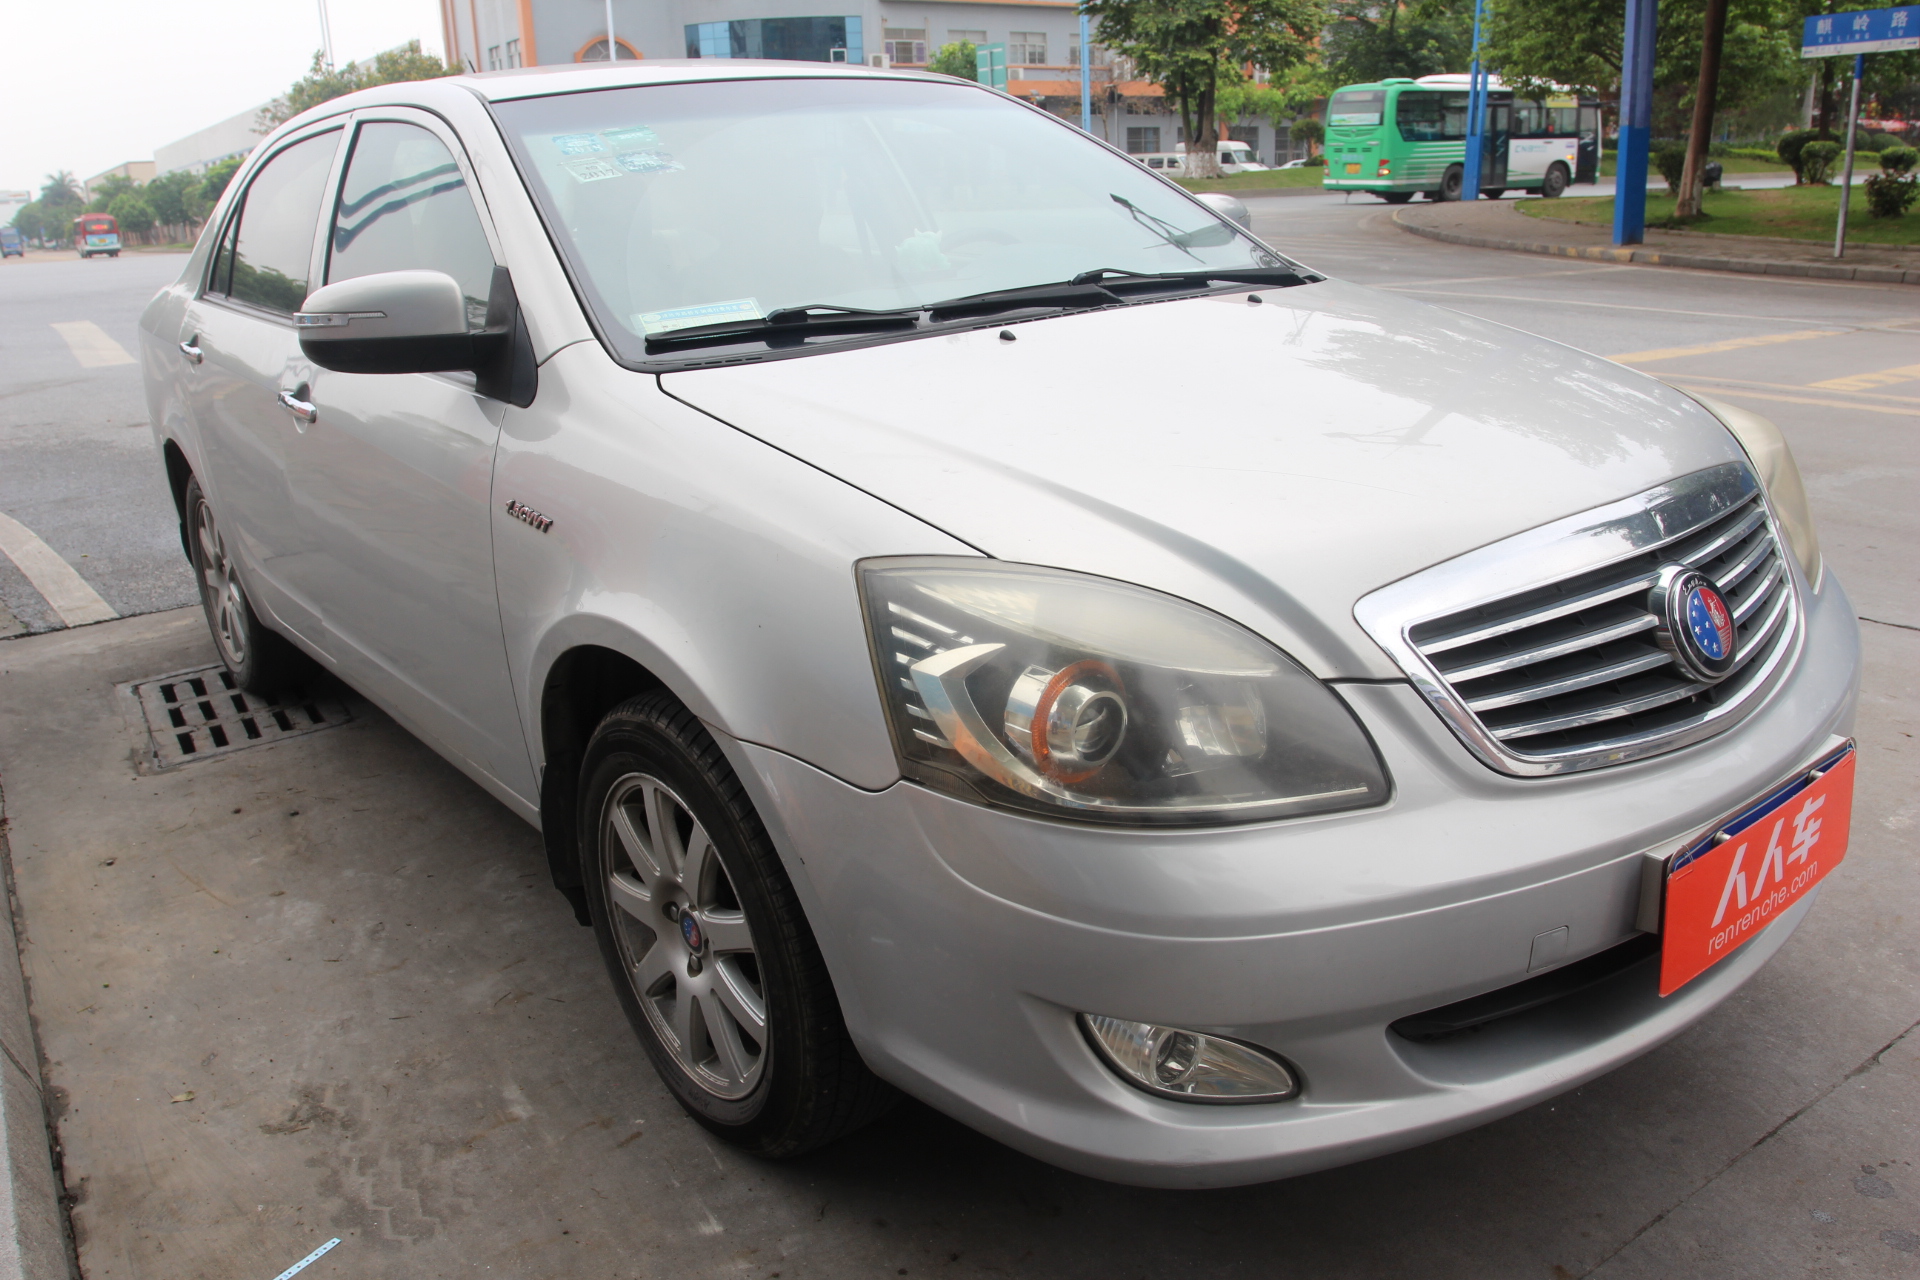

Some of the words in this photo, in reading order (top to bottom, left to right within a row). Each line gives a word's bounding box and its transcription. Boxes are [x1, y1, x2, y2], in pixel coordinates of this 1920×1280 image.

[580, 168, 615, 180] 2017
[1708, 861, 1818, 956] renrenche.com
[1711, 793, 1826, 929] 人人车
